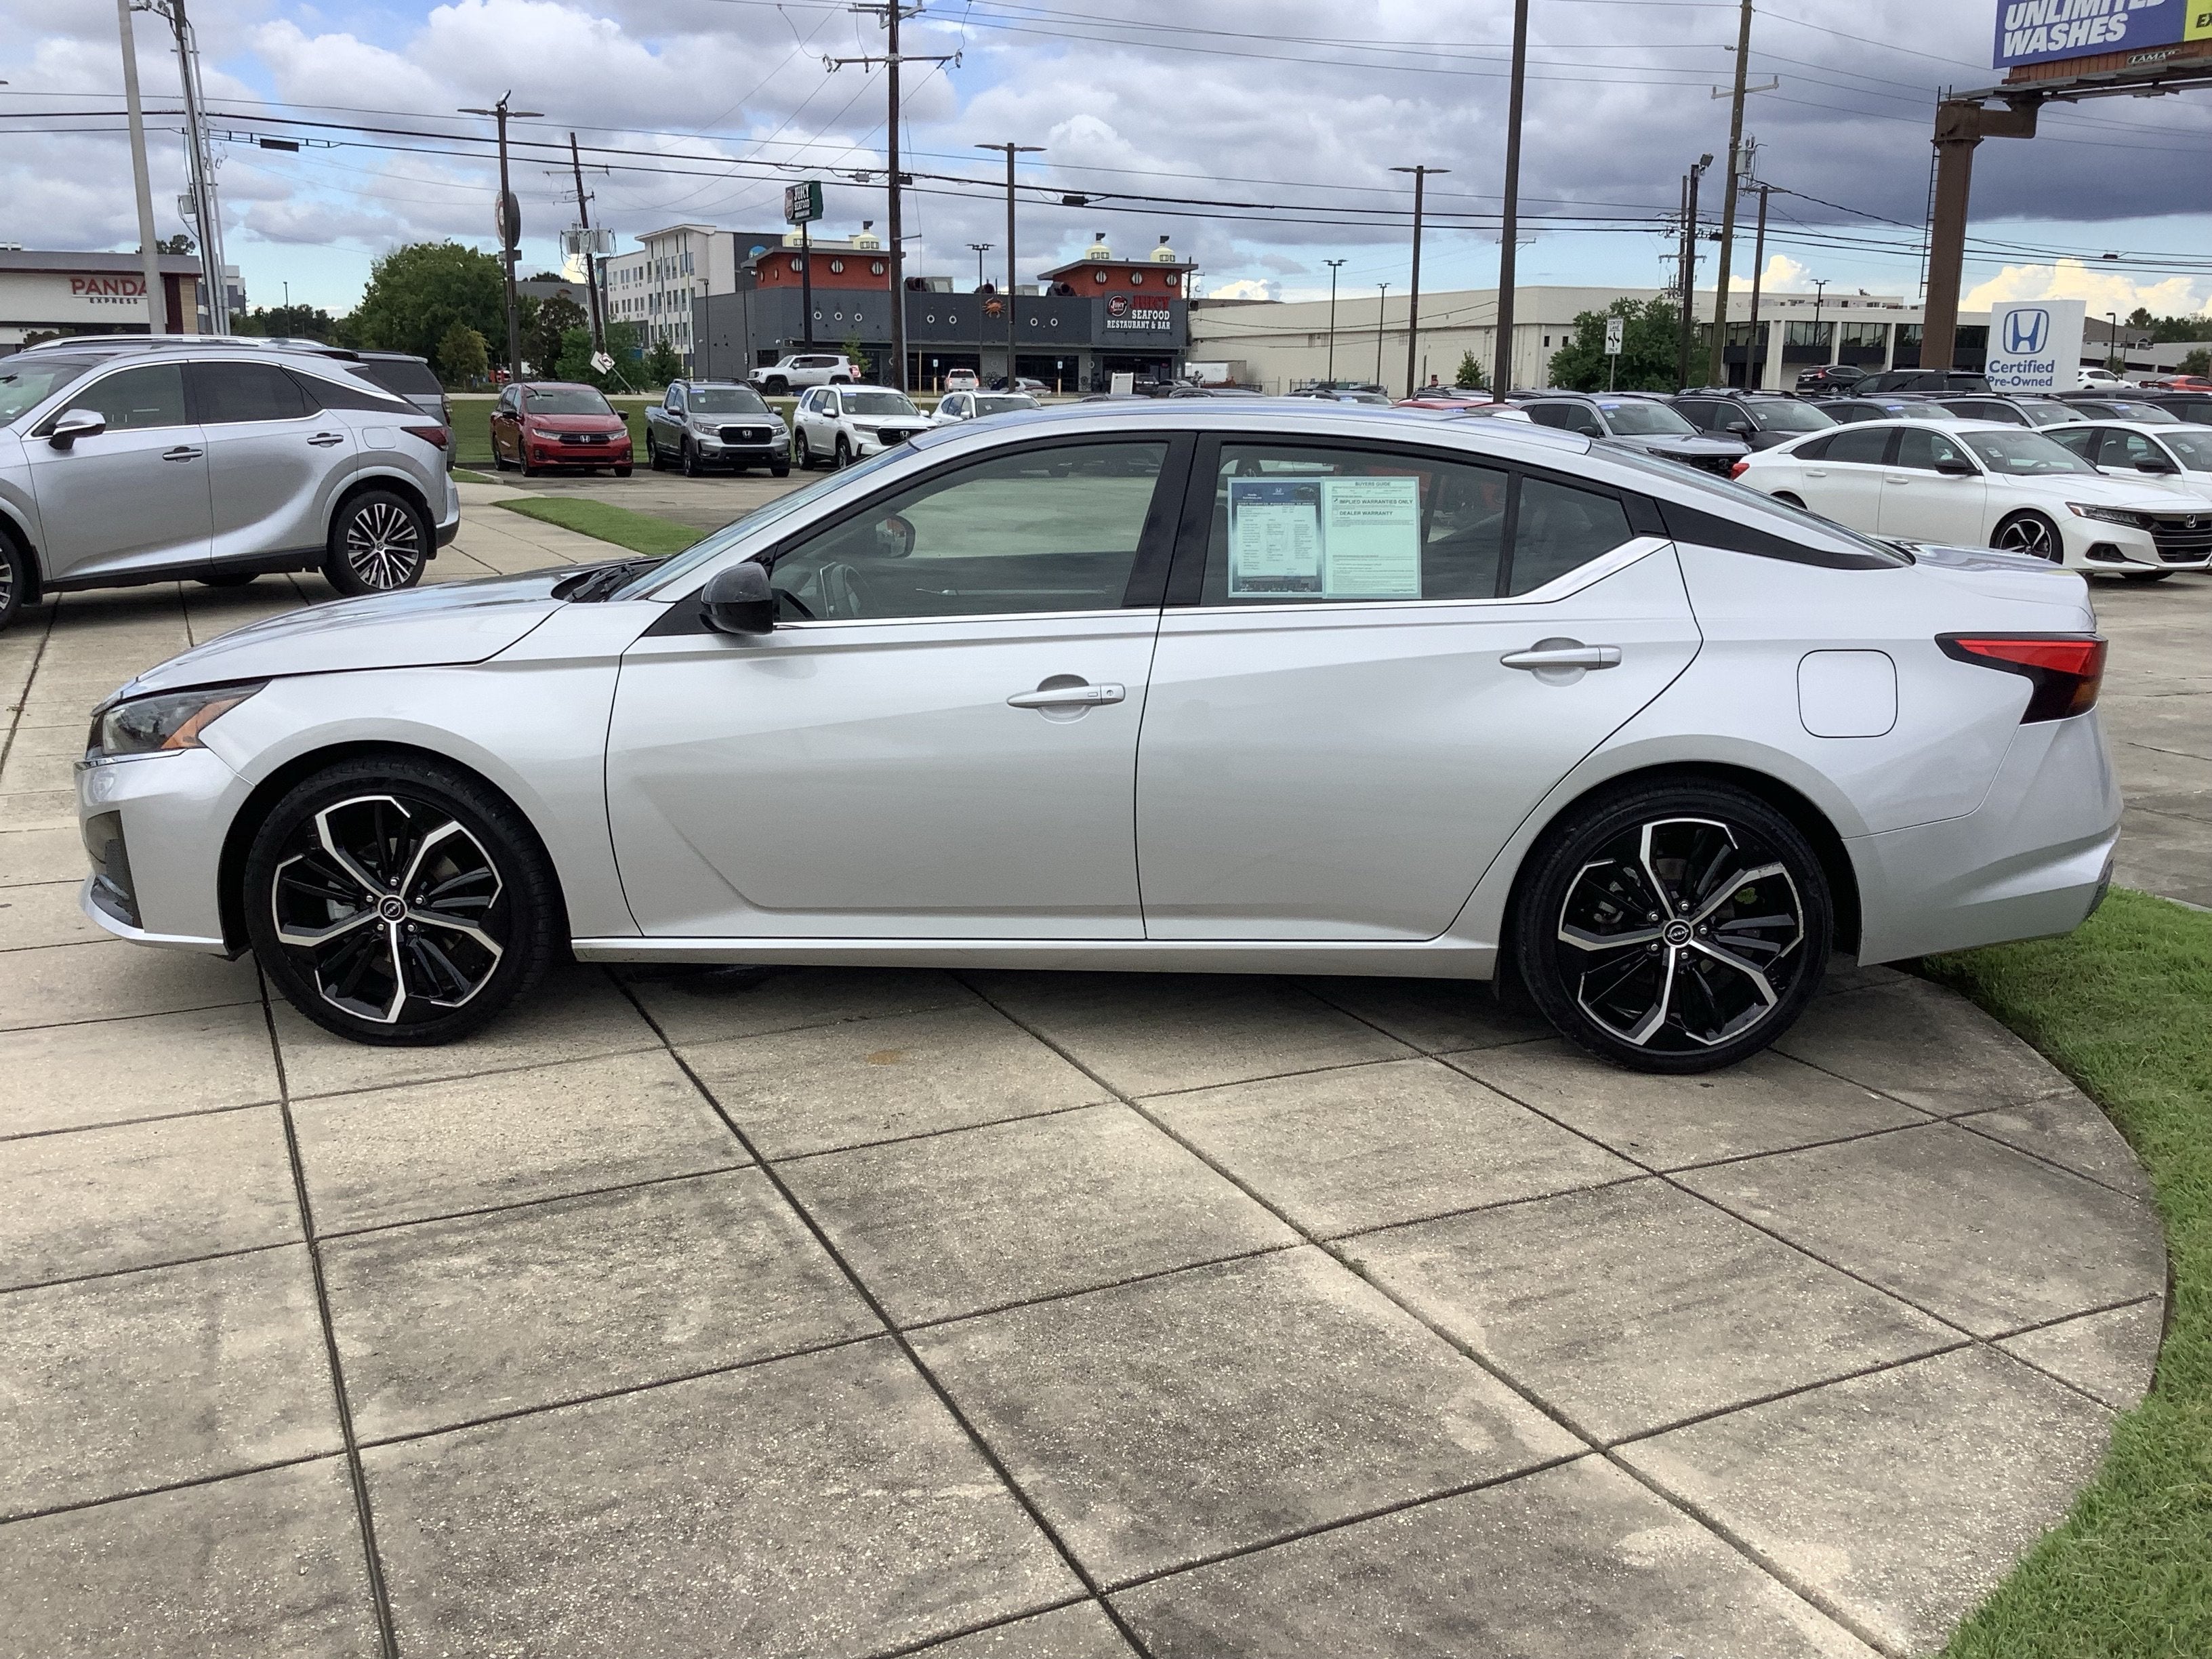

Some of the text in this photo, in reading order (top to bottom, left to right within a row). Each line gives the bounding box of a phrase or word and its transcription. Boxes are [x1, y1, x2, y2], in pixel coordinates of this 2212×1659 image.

[2005, 0, 2165, 30] UNLIMI
[2003, 13, 2129, 58] WASHES
[794, 184, 810, 201] JUICY
[1130, 295, 1170, 310] JUICY
[1132, 310, 1170, 320] SEAFOOD
[1107, 320, 1170, 329] RESTAURANT & BAR
[1989, 360, 2055, 373] Certified
[1988, 375, 2053, 386] Pre-Owned
